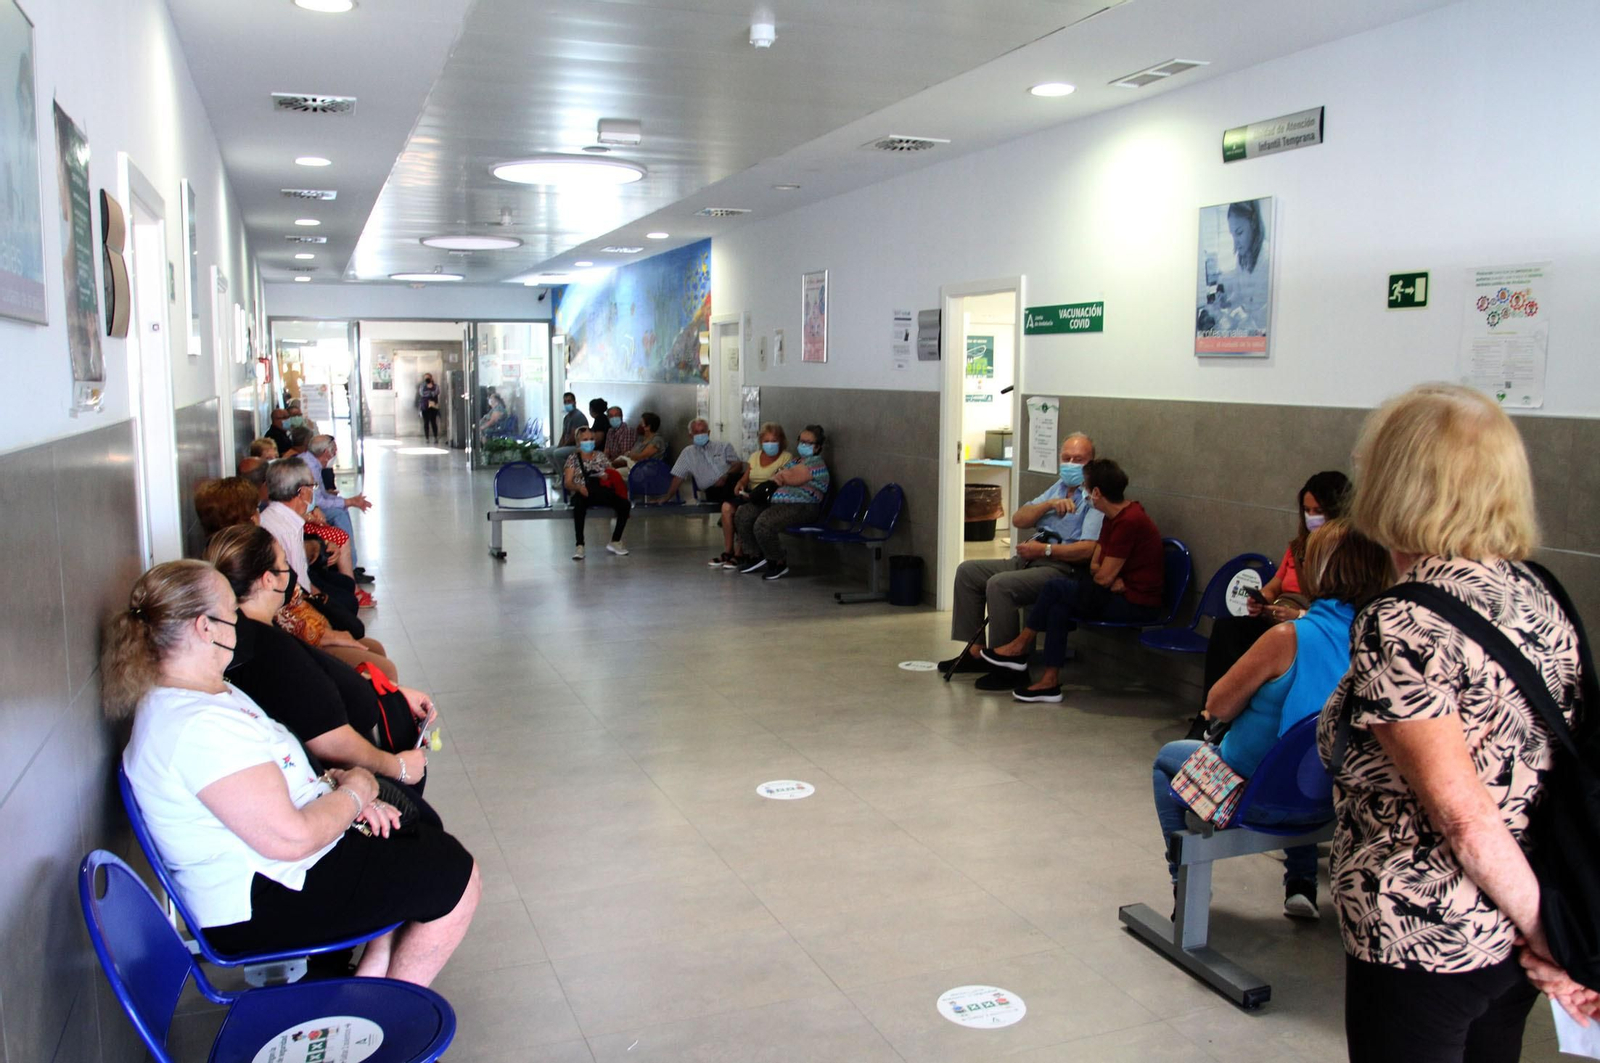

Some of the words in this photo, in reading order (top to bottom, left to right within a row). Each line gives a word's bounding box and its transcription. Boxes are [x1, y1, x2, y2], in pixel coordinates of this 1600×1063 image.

[1286, 117, 1315, 132] Atención
[1259, 137, 1280, 152] Infantil
[1282, 132, 1315, 147] Temprana
[1059, 303, 1102, 319] VACUNACIÓN
[1069, 318, 1090, 329] COVID
